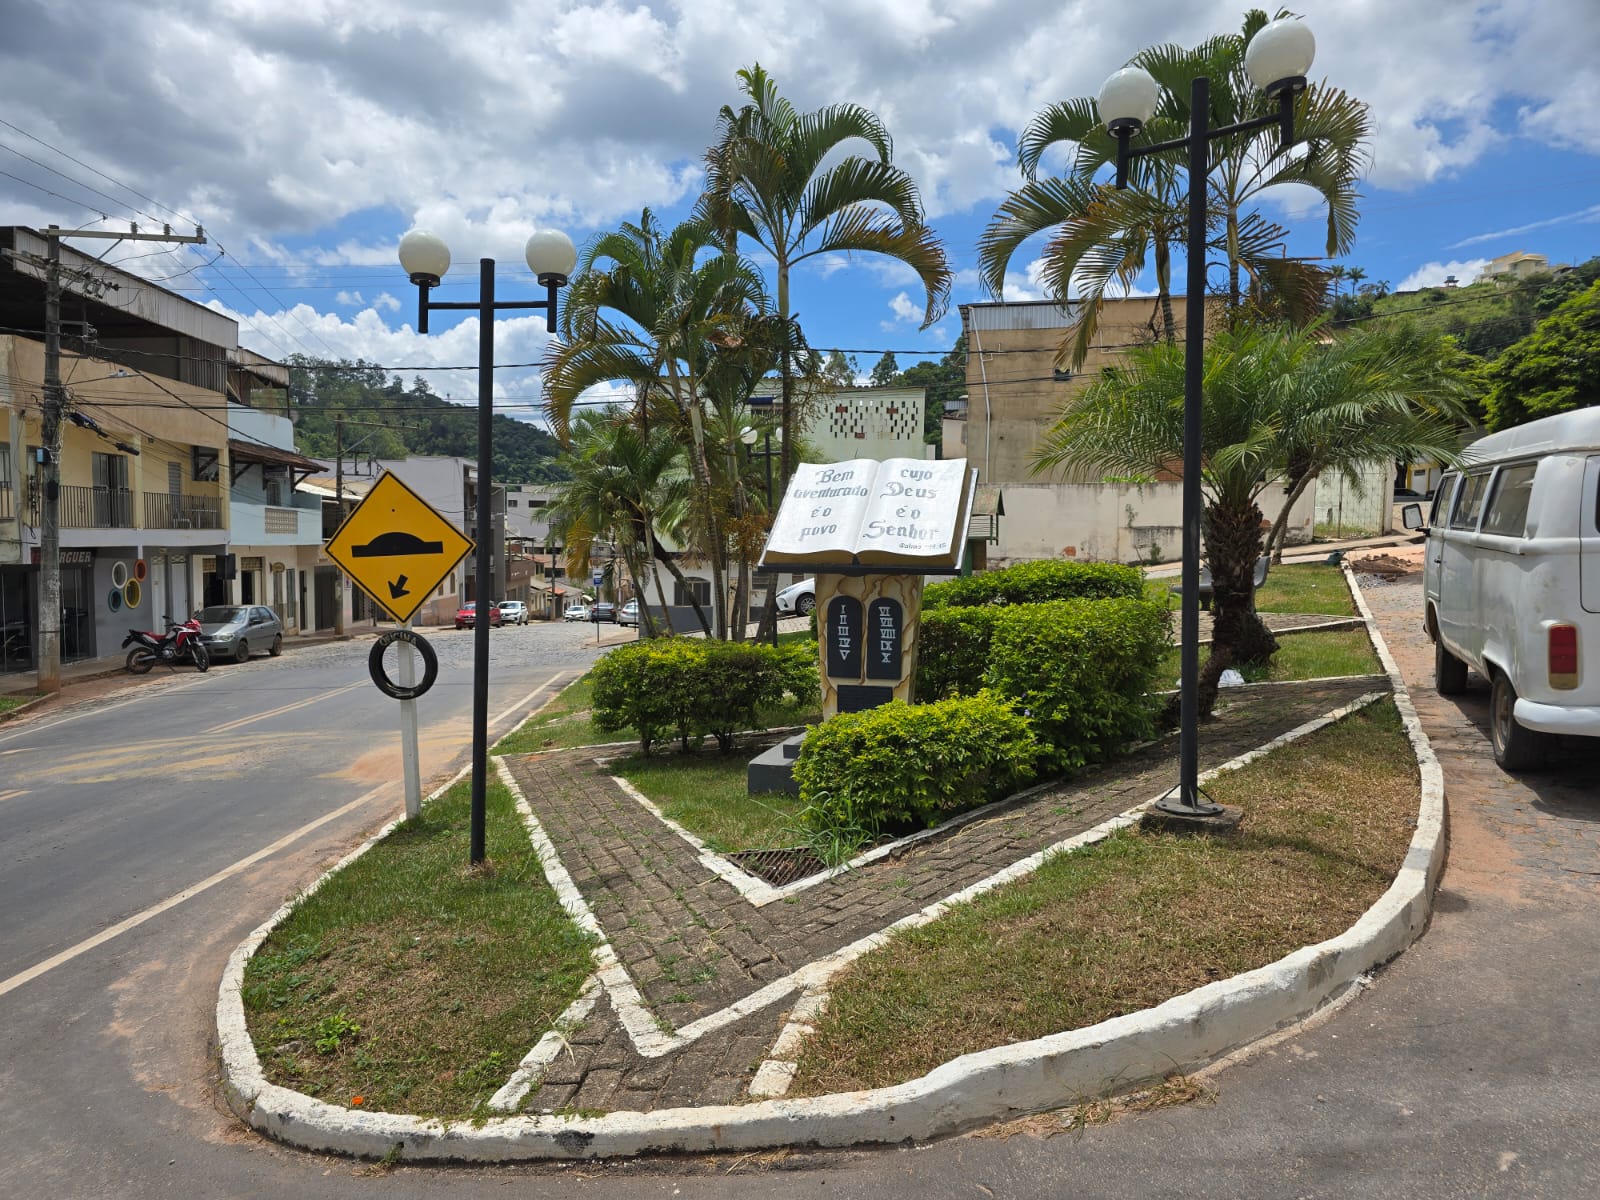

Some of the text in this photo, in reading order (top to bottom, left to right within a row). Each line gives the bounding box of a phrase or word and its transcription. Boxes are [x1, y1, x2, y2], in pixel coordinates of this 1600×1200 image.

[816, 469, 855, 485] Bem
[900, 469, 933, 482] cujo
[880, 482, 937, 499] Deus
[811, 506, 832, 518] é o
[896, 505, 921, 520] é o
[798, 524, 837, 541] povo
[863, 520, 940, 540] Senhor
[841, 605, 846, 614] I
[878, 606, 891, 617] VI
[840, 615, 847, 625] II
[880, 617, 893, 627] VII
[838, 626, 849, 636] III
[880, 629, 896, 639] VIII
[838, 638, 851, 648] IV
[880, 640, 893, 650] IX
[840, 649, 851, 661] V
[881, 652, 892, 663] X
